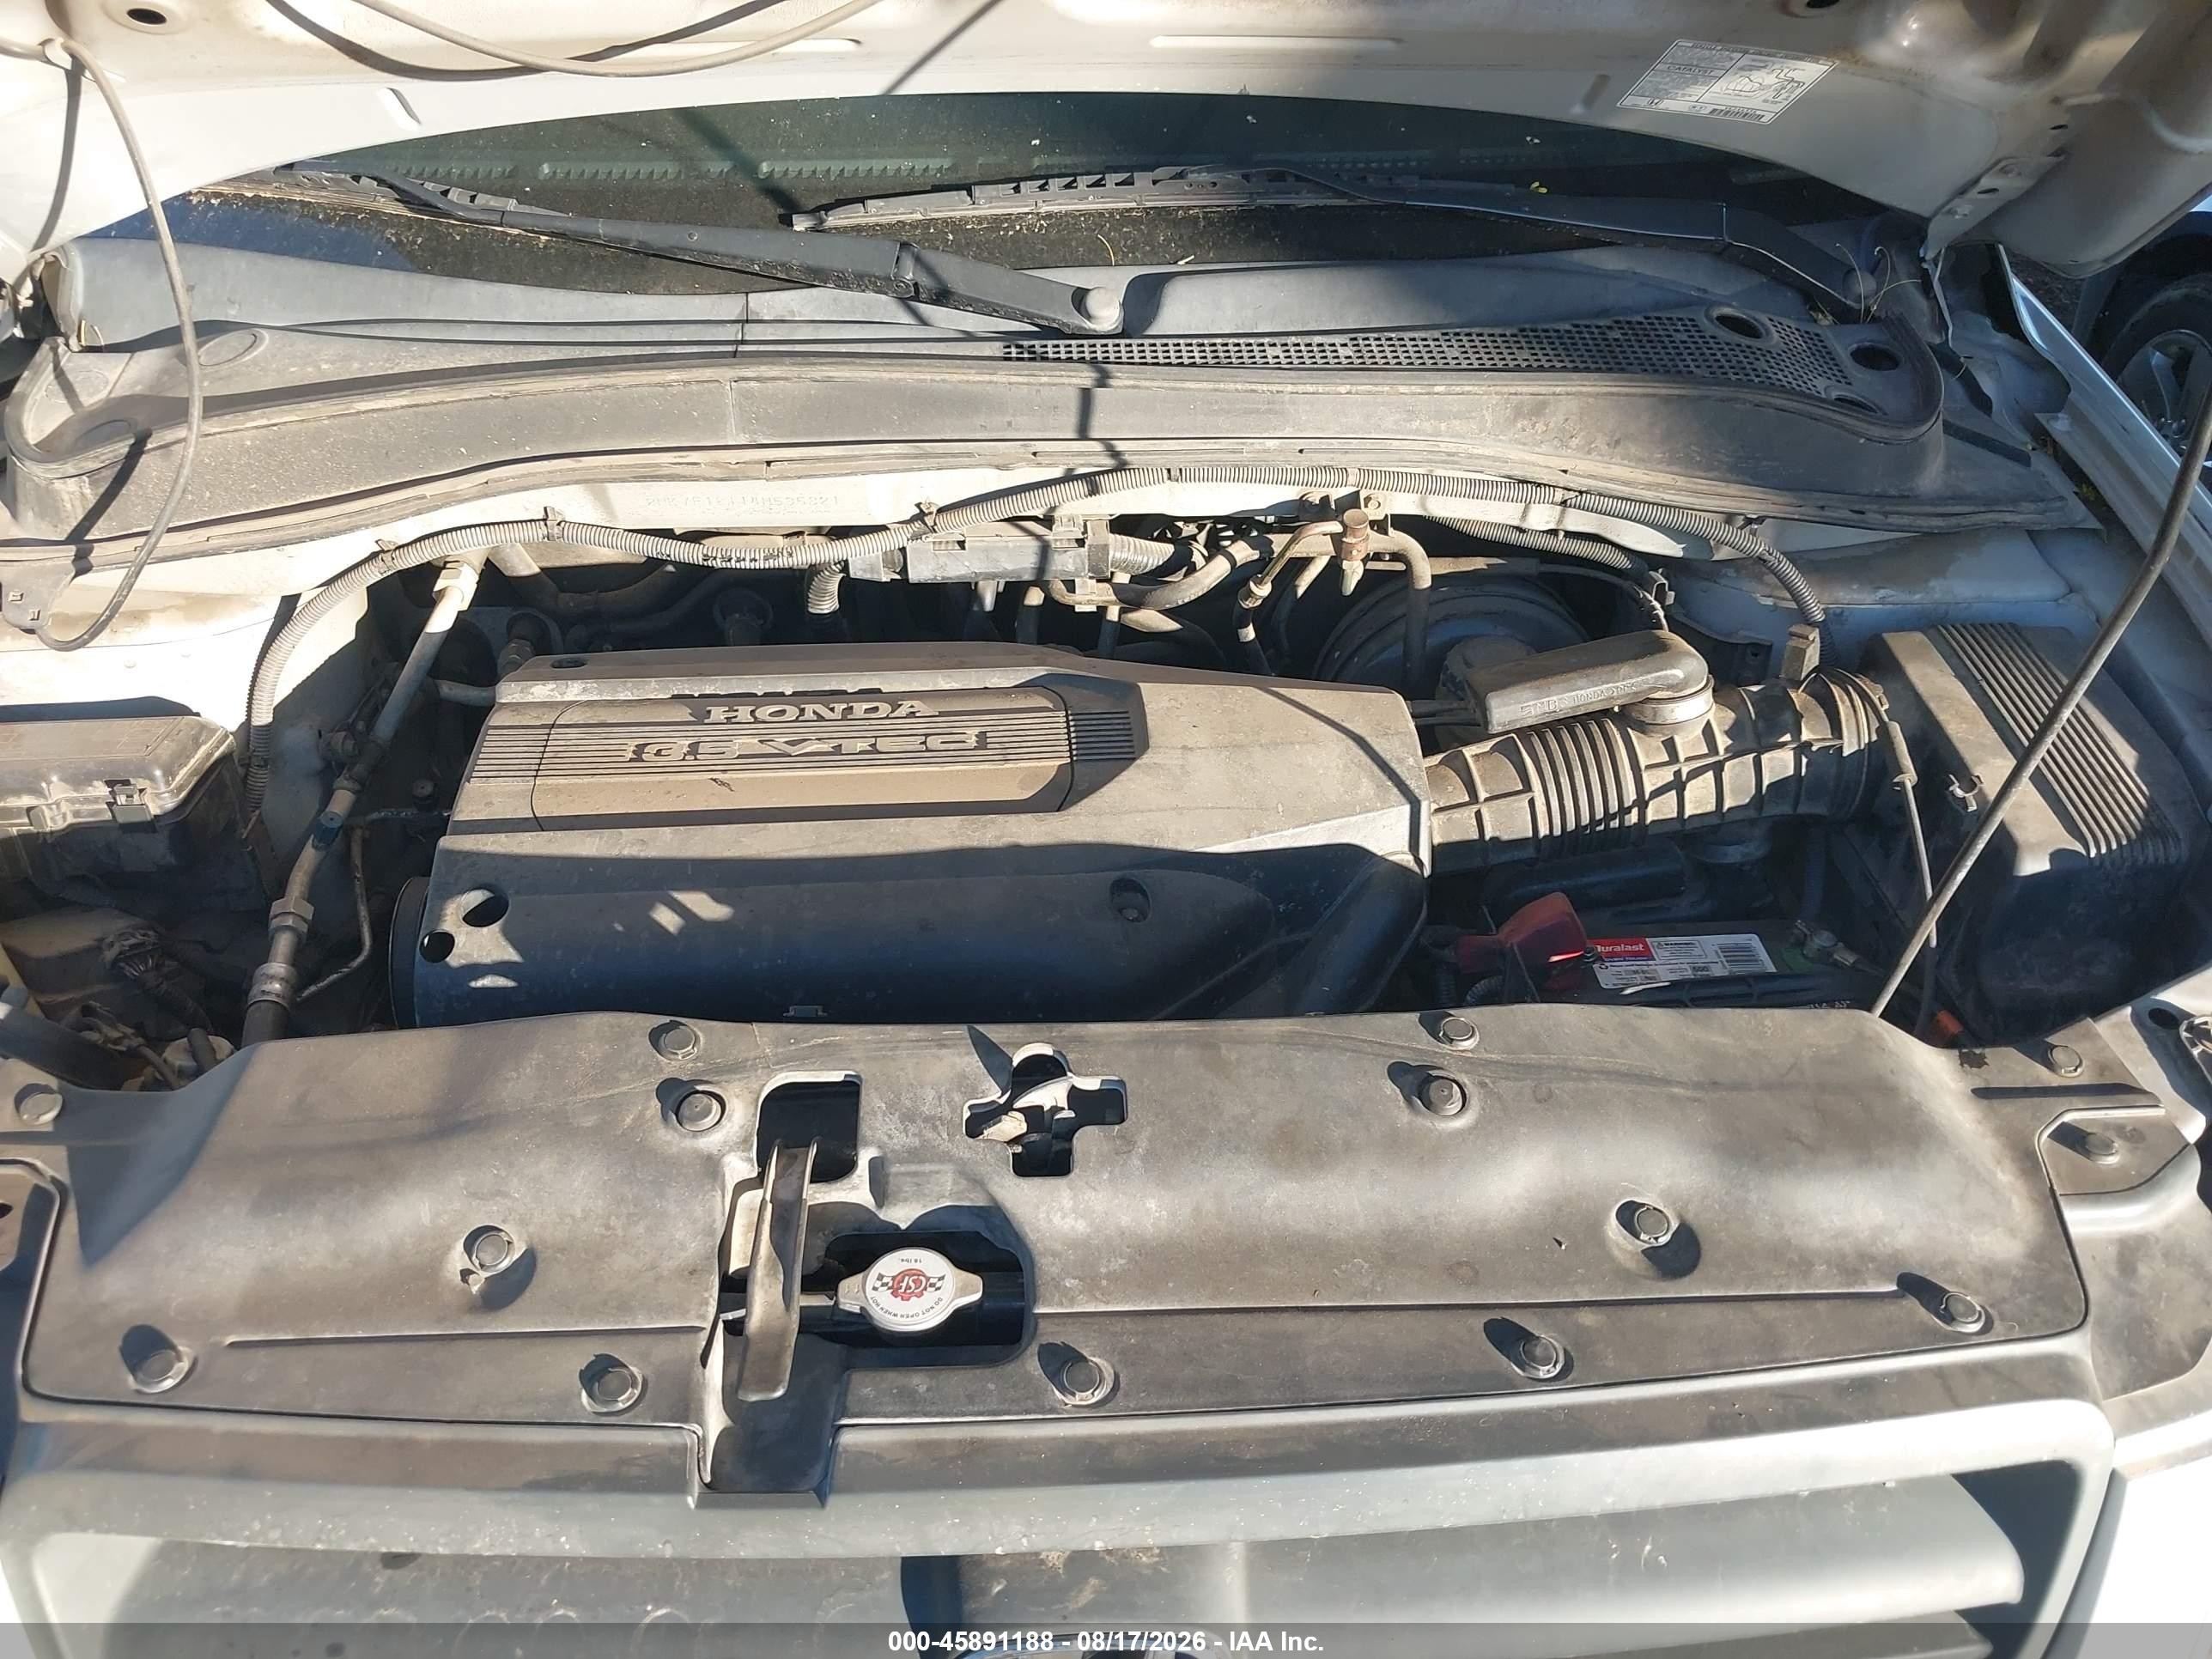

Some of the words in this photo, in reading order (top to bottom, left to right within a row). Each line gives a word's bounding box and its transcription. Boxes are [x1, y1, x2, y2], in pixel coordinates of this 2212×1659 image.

[1667, 65, 1714, 75] CATALYST
[702, 700, 941, 725] HONDA
[641, 740, 741, 762] 3.5
[898, 1275, 927, 1293] CSF
[871, 1296, 881, 1307] HOT
[933, 1297, 943, 1306] DO
[880, 1307, 898, 1317] WHEN
[921, 1306, 935, 1316] NOT
